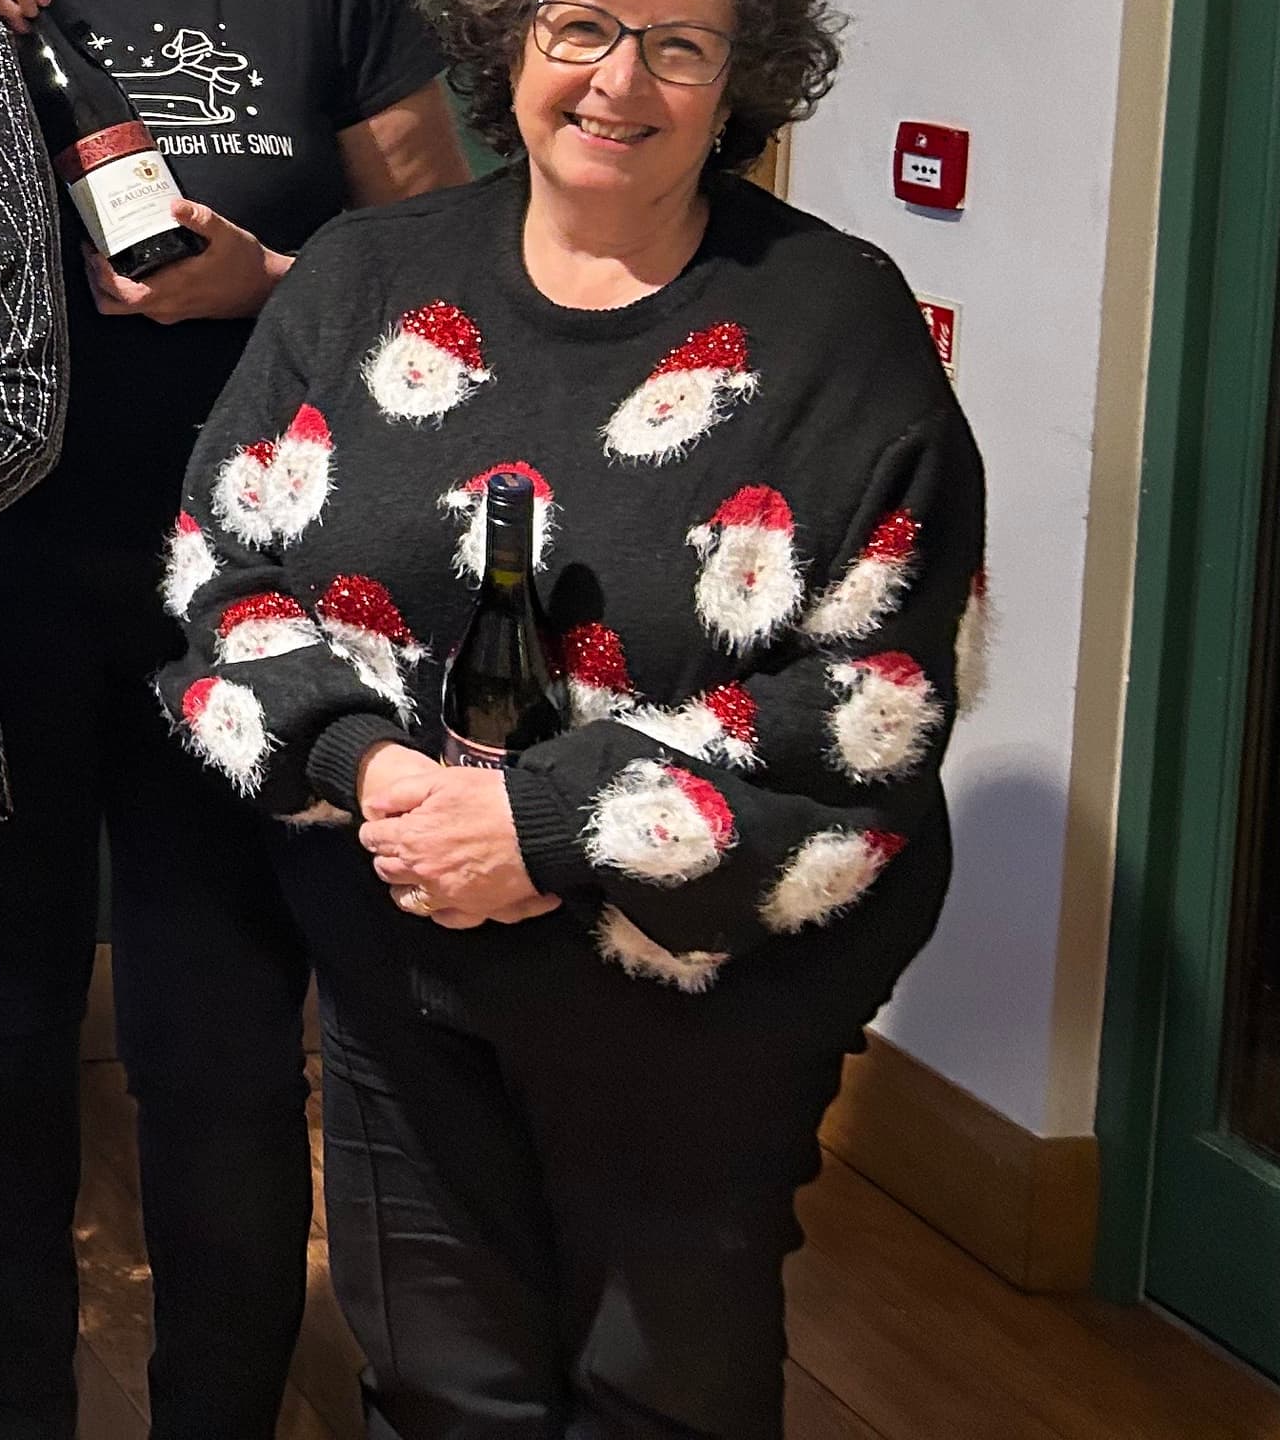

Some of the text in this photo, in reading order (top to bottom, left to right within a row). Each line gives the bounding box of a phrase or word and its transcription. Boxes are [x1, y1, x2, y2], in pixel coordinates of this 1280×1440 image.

[156, 133, 293, 157] OUGH THE SNOW
[110, 181, 171, 209] BEAUJOLAIS
